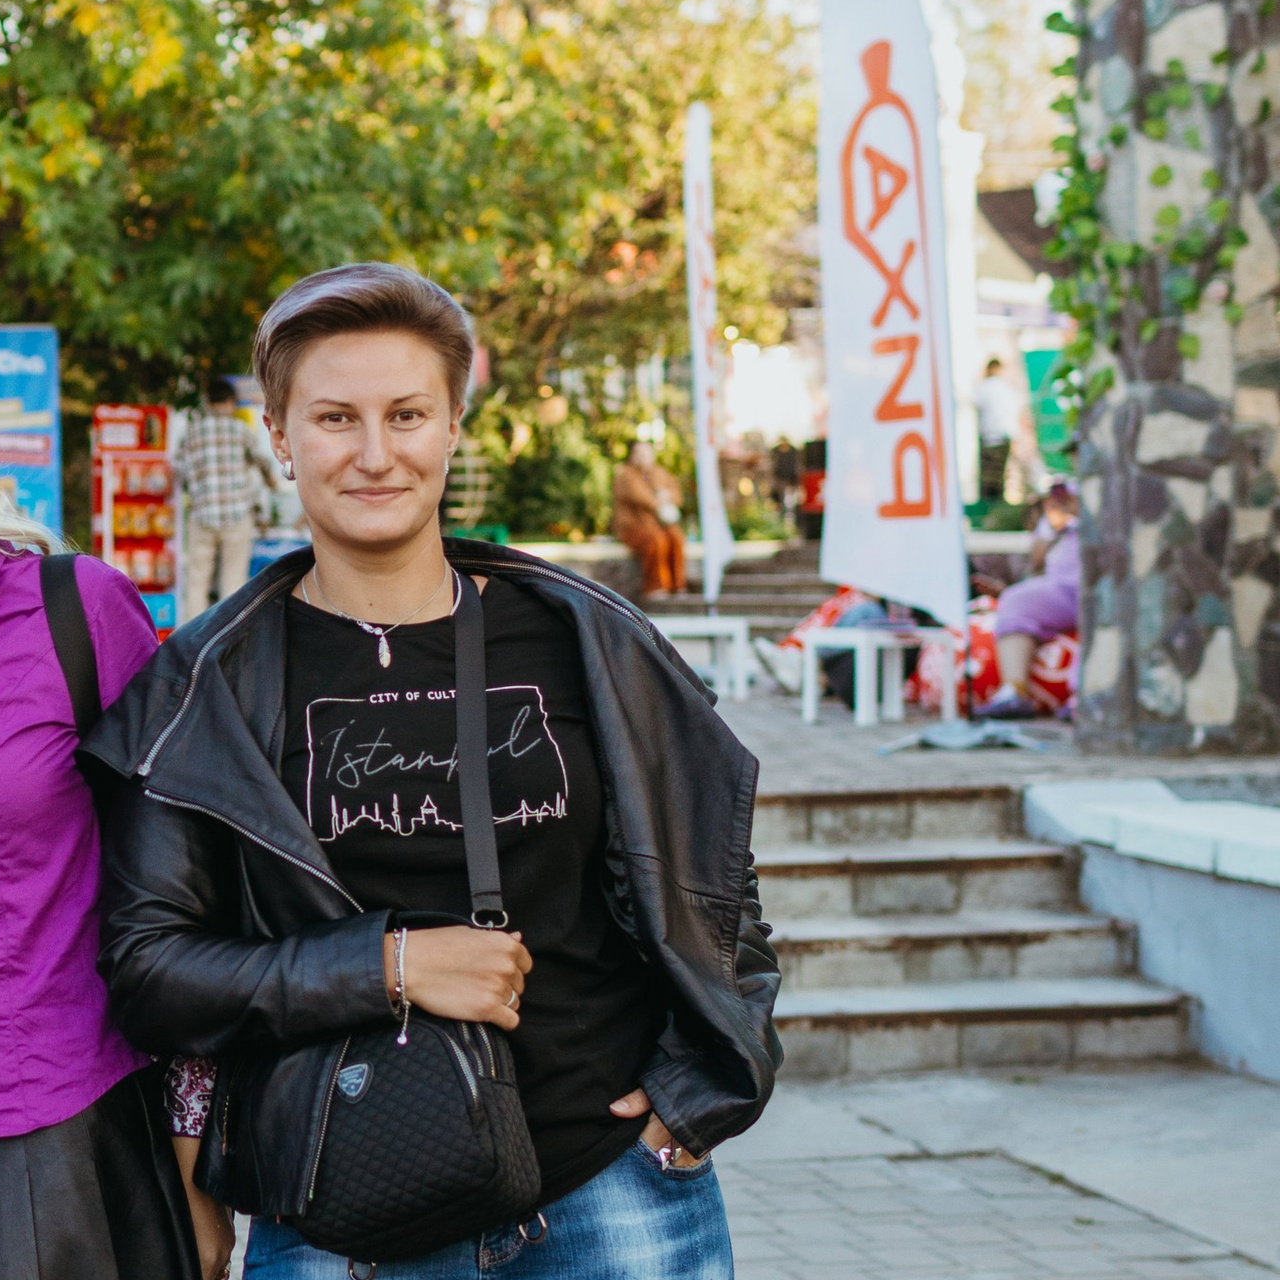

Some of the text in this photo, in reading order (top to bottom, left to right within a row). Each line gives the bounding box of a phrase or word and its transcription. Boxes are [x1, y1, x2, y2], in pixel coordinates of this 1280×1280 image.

[369, 689, 457, 704] CITY OF CULT
